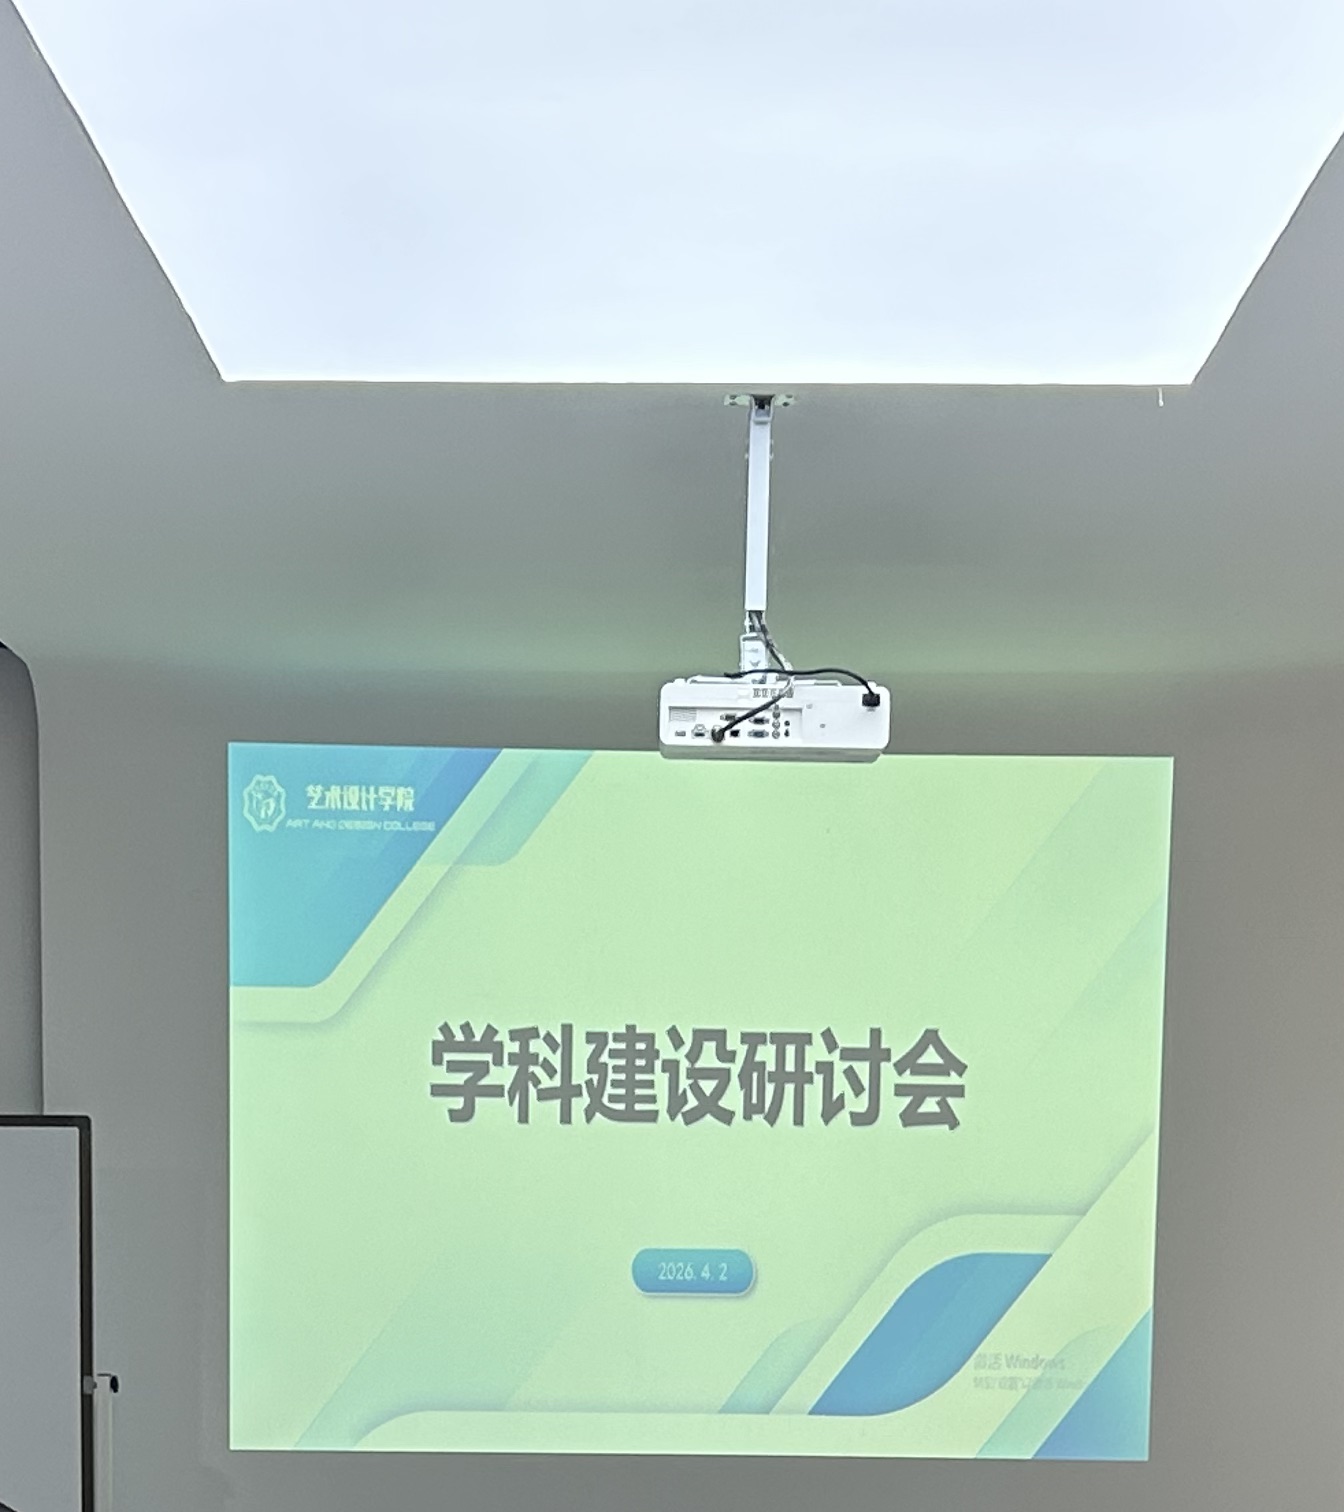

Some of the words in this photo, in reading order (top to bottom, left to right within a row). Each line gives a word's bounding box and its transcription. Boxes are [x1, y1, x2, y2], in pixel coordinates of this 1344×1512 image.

[306, 784, 415, 812] 艺术设计学院
[285, 818, 310, 829] ART
[384, 819, 436, 832] COLLEGE
[429, 1020, 968, 1131] 学科建设研讨会
